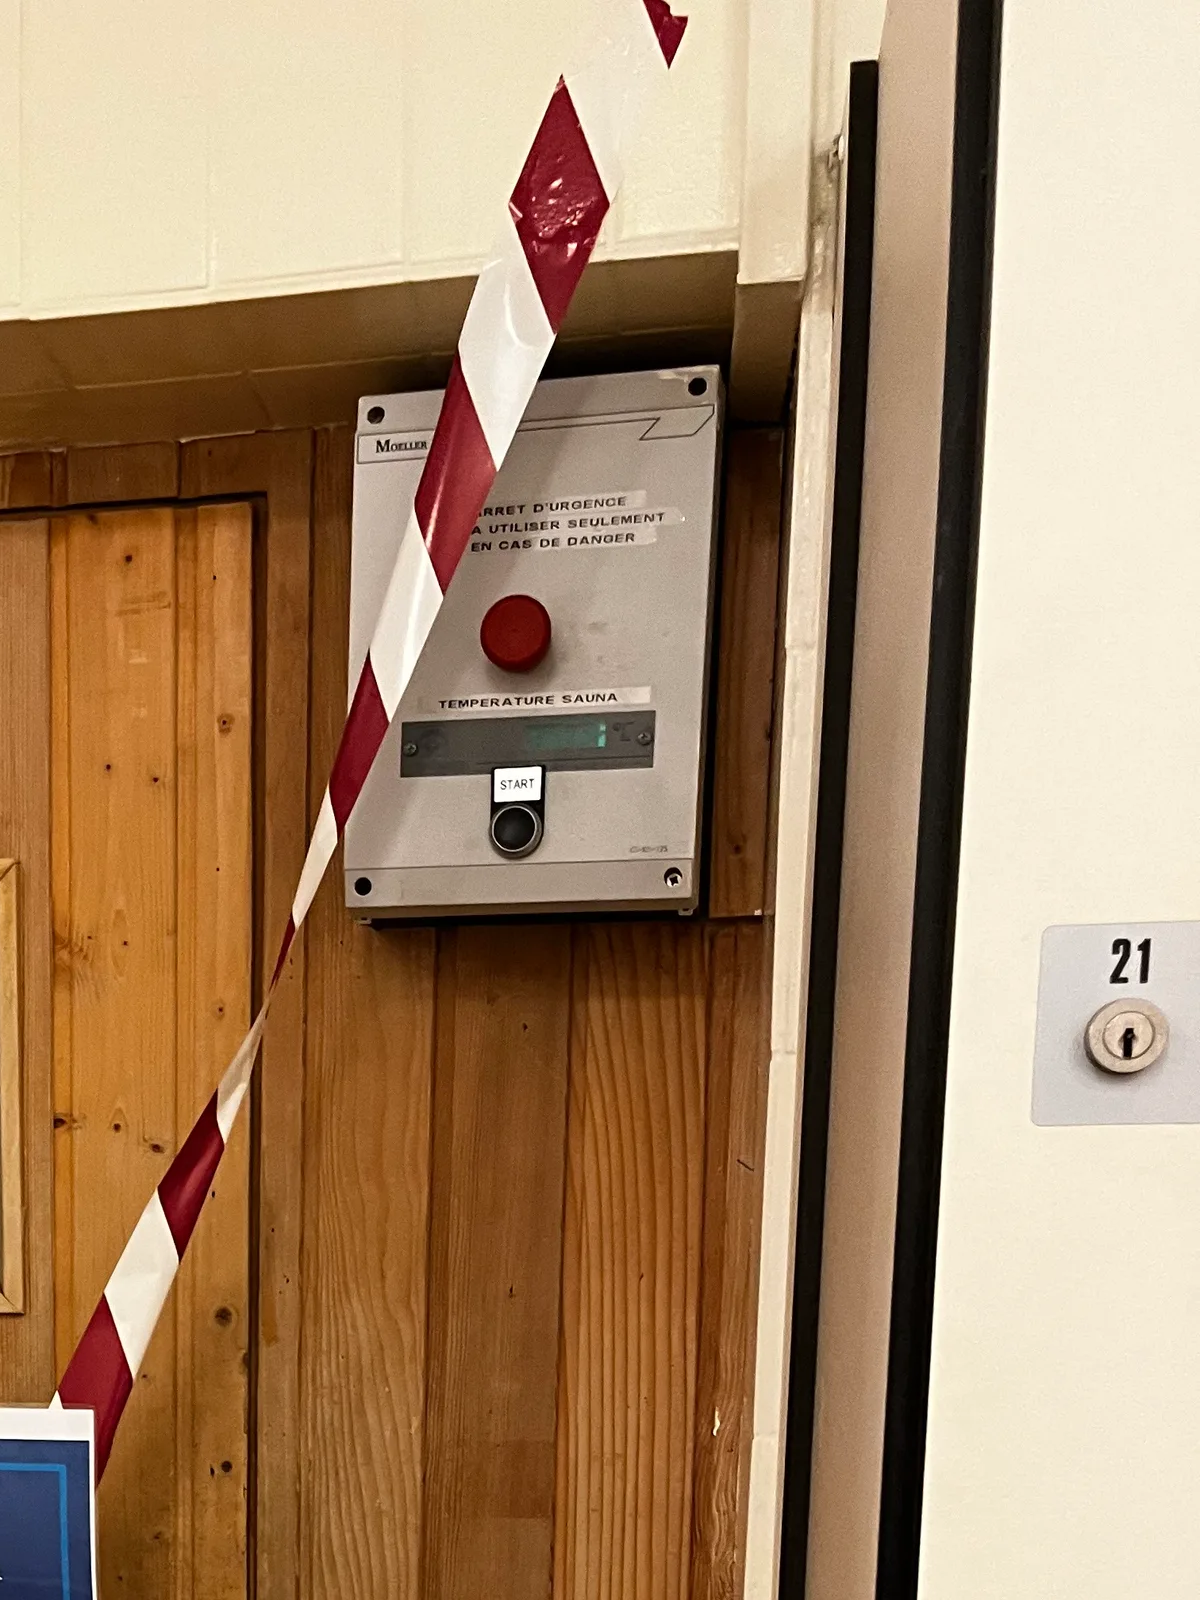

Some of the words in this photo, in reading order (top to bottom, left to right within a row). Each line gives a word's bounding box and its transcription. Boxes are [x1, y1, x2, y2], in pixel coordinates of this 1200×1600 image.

[478, 504, 526, 517] RRET
[533, 496, 627, 514] D'URGENCE
[488, 520, 560, 535] UTILISER
[568, 512, 665, 529] SEULEMENT
[471, 541, 492, 552] EN
[499, 539, 533, 550] CAS
[539, 537, 560, 549] DE
[567, 532, 636, 547] DANGER
[438, 694, 555, 710] TEMPERATURE
[562, 692, 618, 704] SAUNA
[500, 778, 535, 790] START
[1109, 938, 1152, 984] 21
